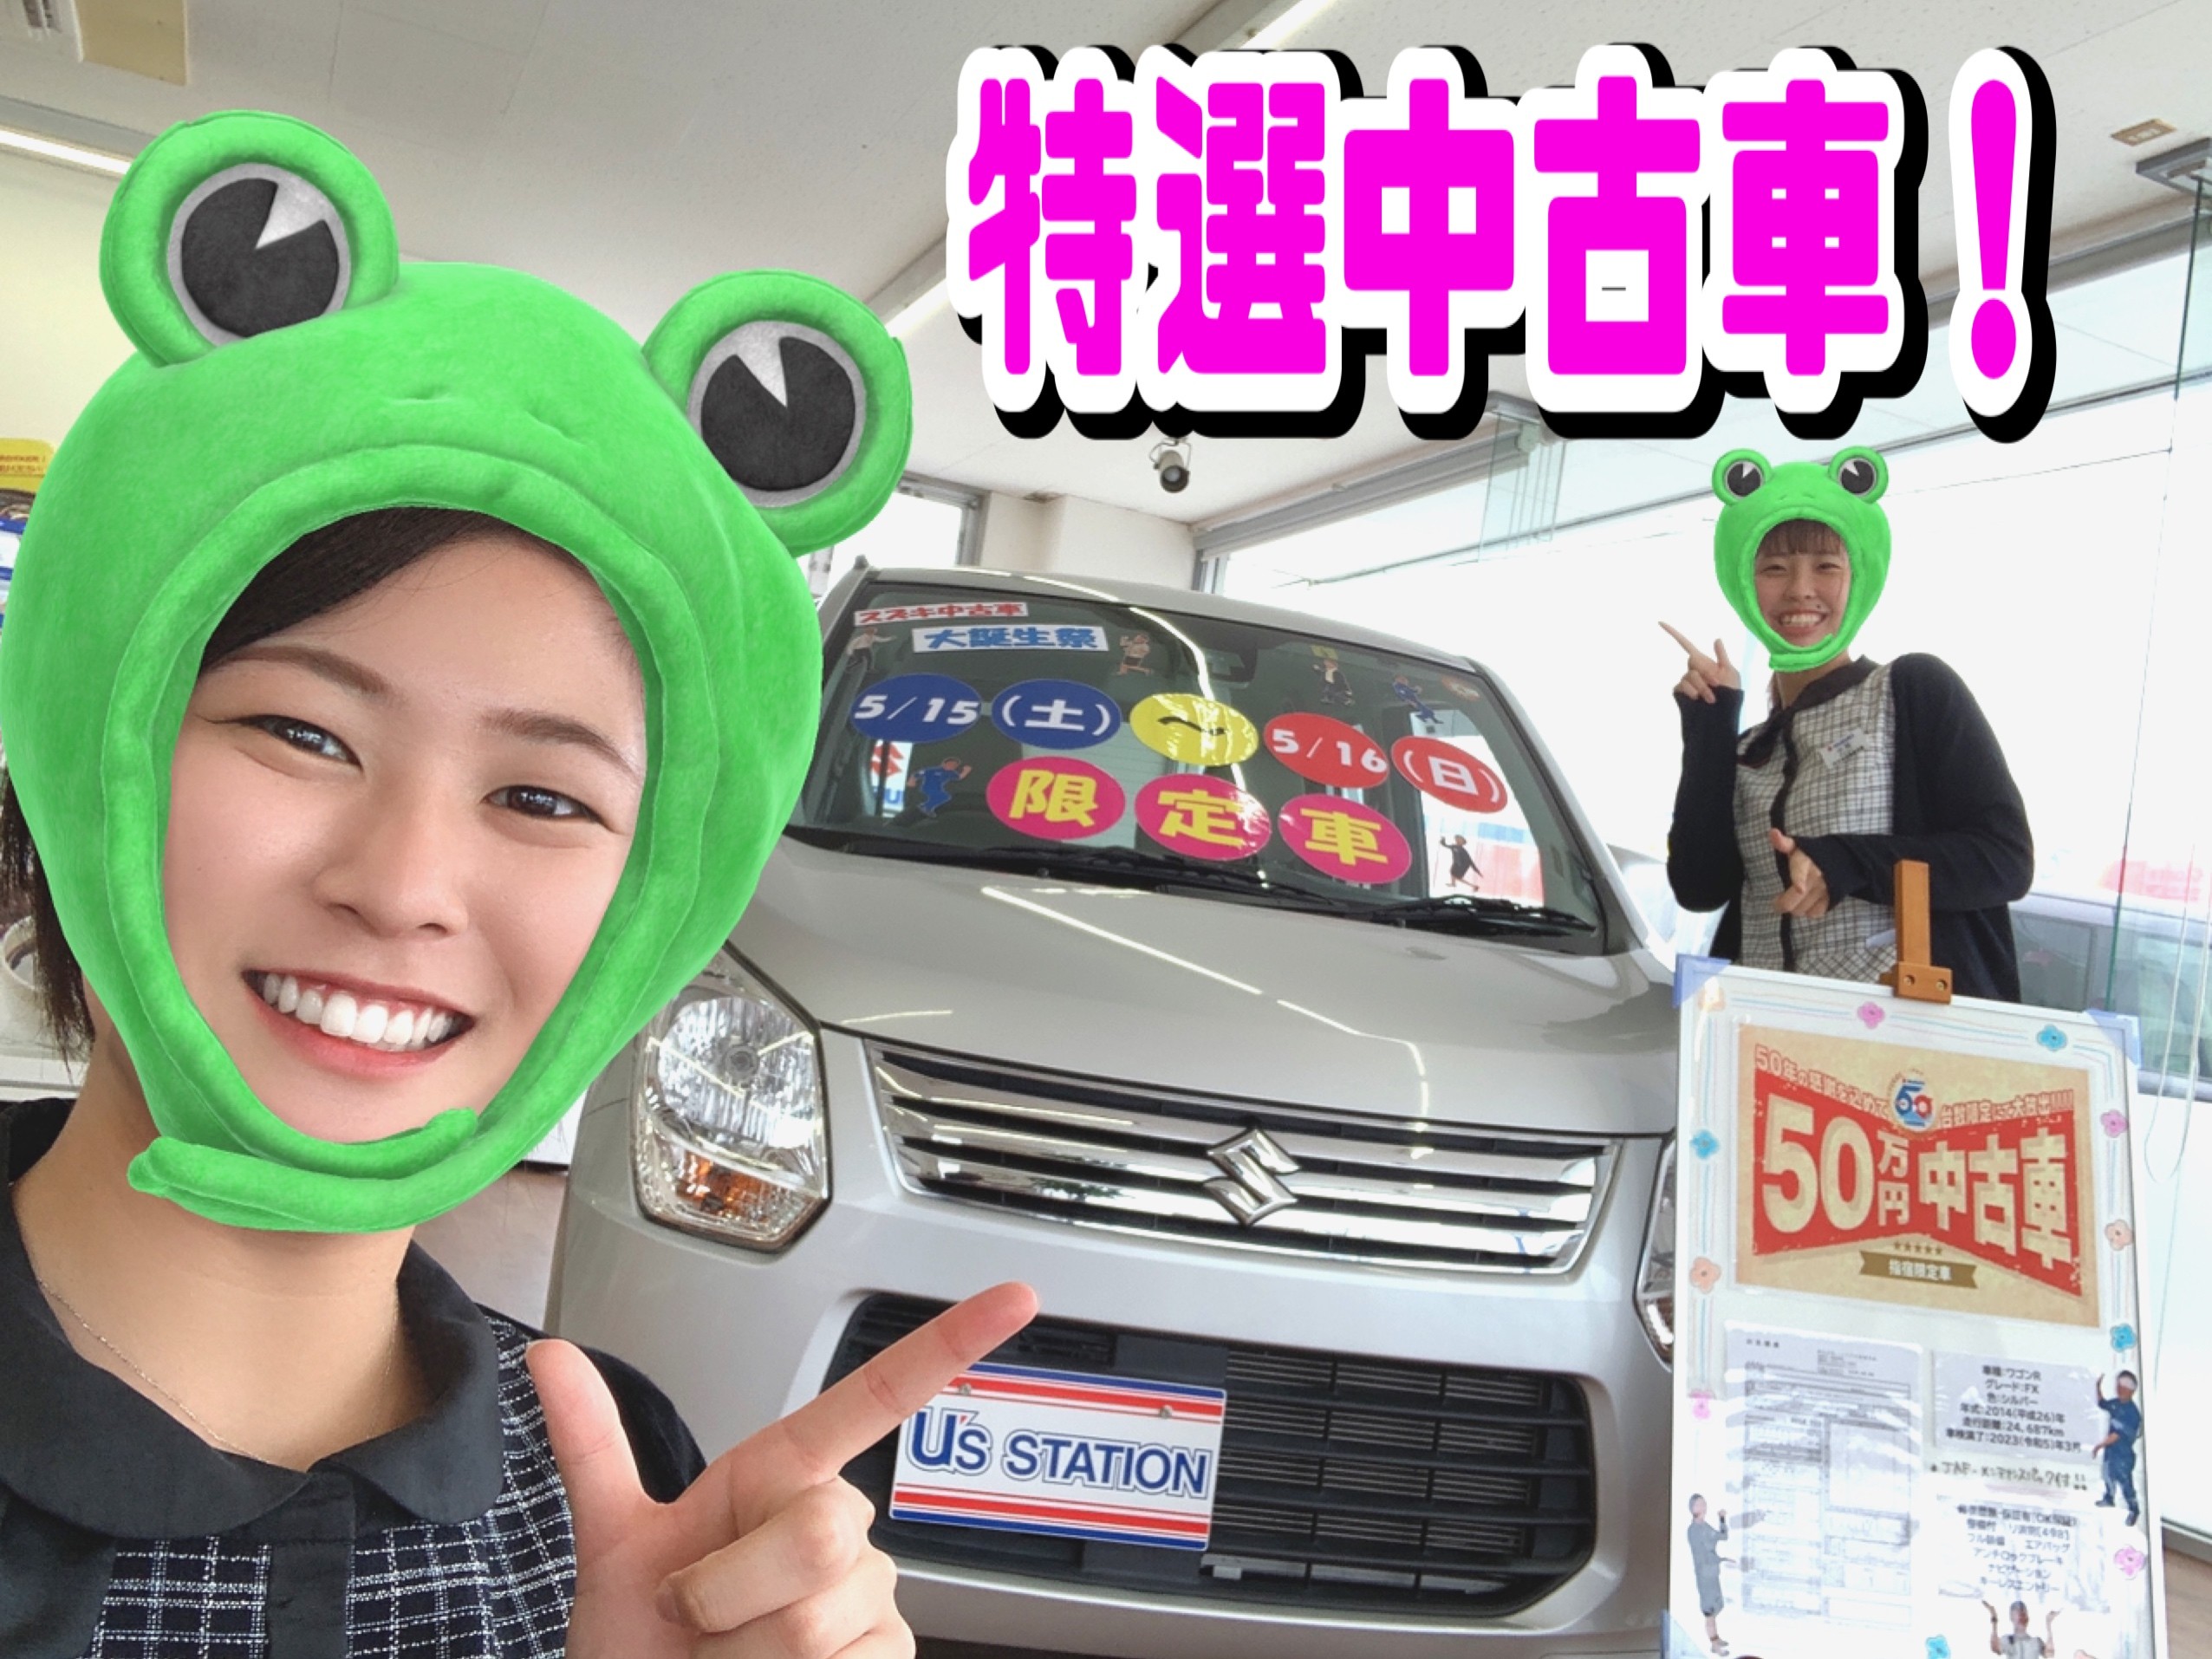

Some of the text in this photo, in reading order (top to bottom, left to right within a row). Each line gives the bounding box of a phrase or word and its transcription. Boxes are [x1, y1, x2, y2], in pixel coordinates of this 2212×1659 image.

[923, 628, 1098, 650] 大誕生祭
[854, 695, 979, 725] 5/15
[1271, 728, 1387, 773] 5/16
[1006, 1435, 1207, 1494] STATION
